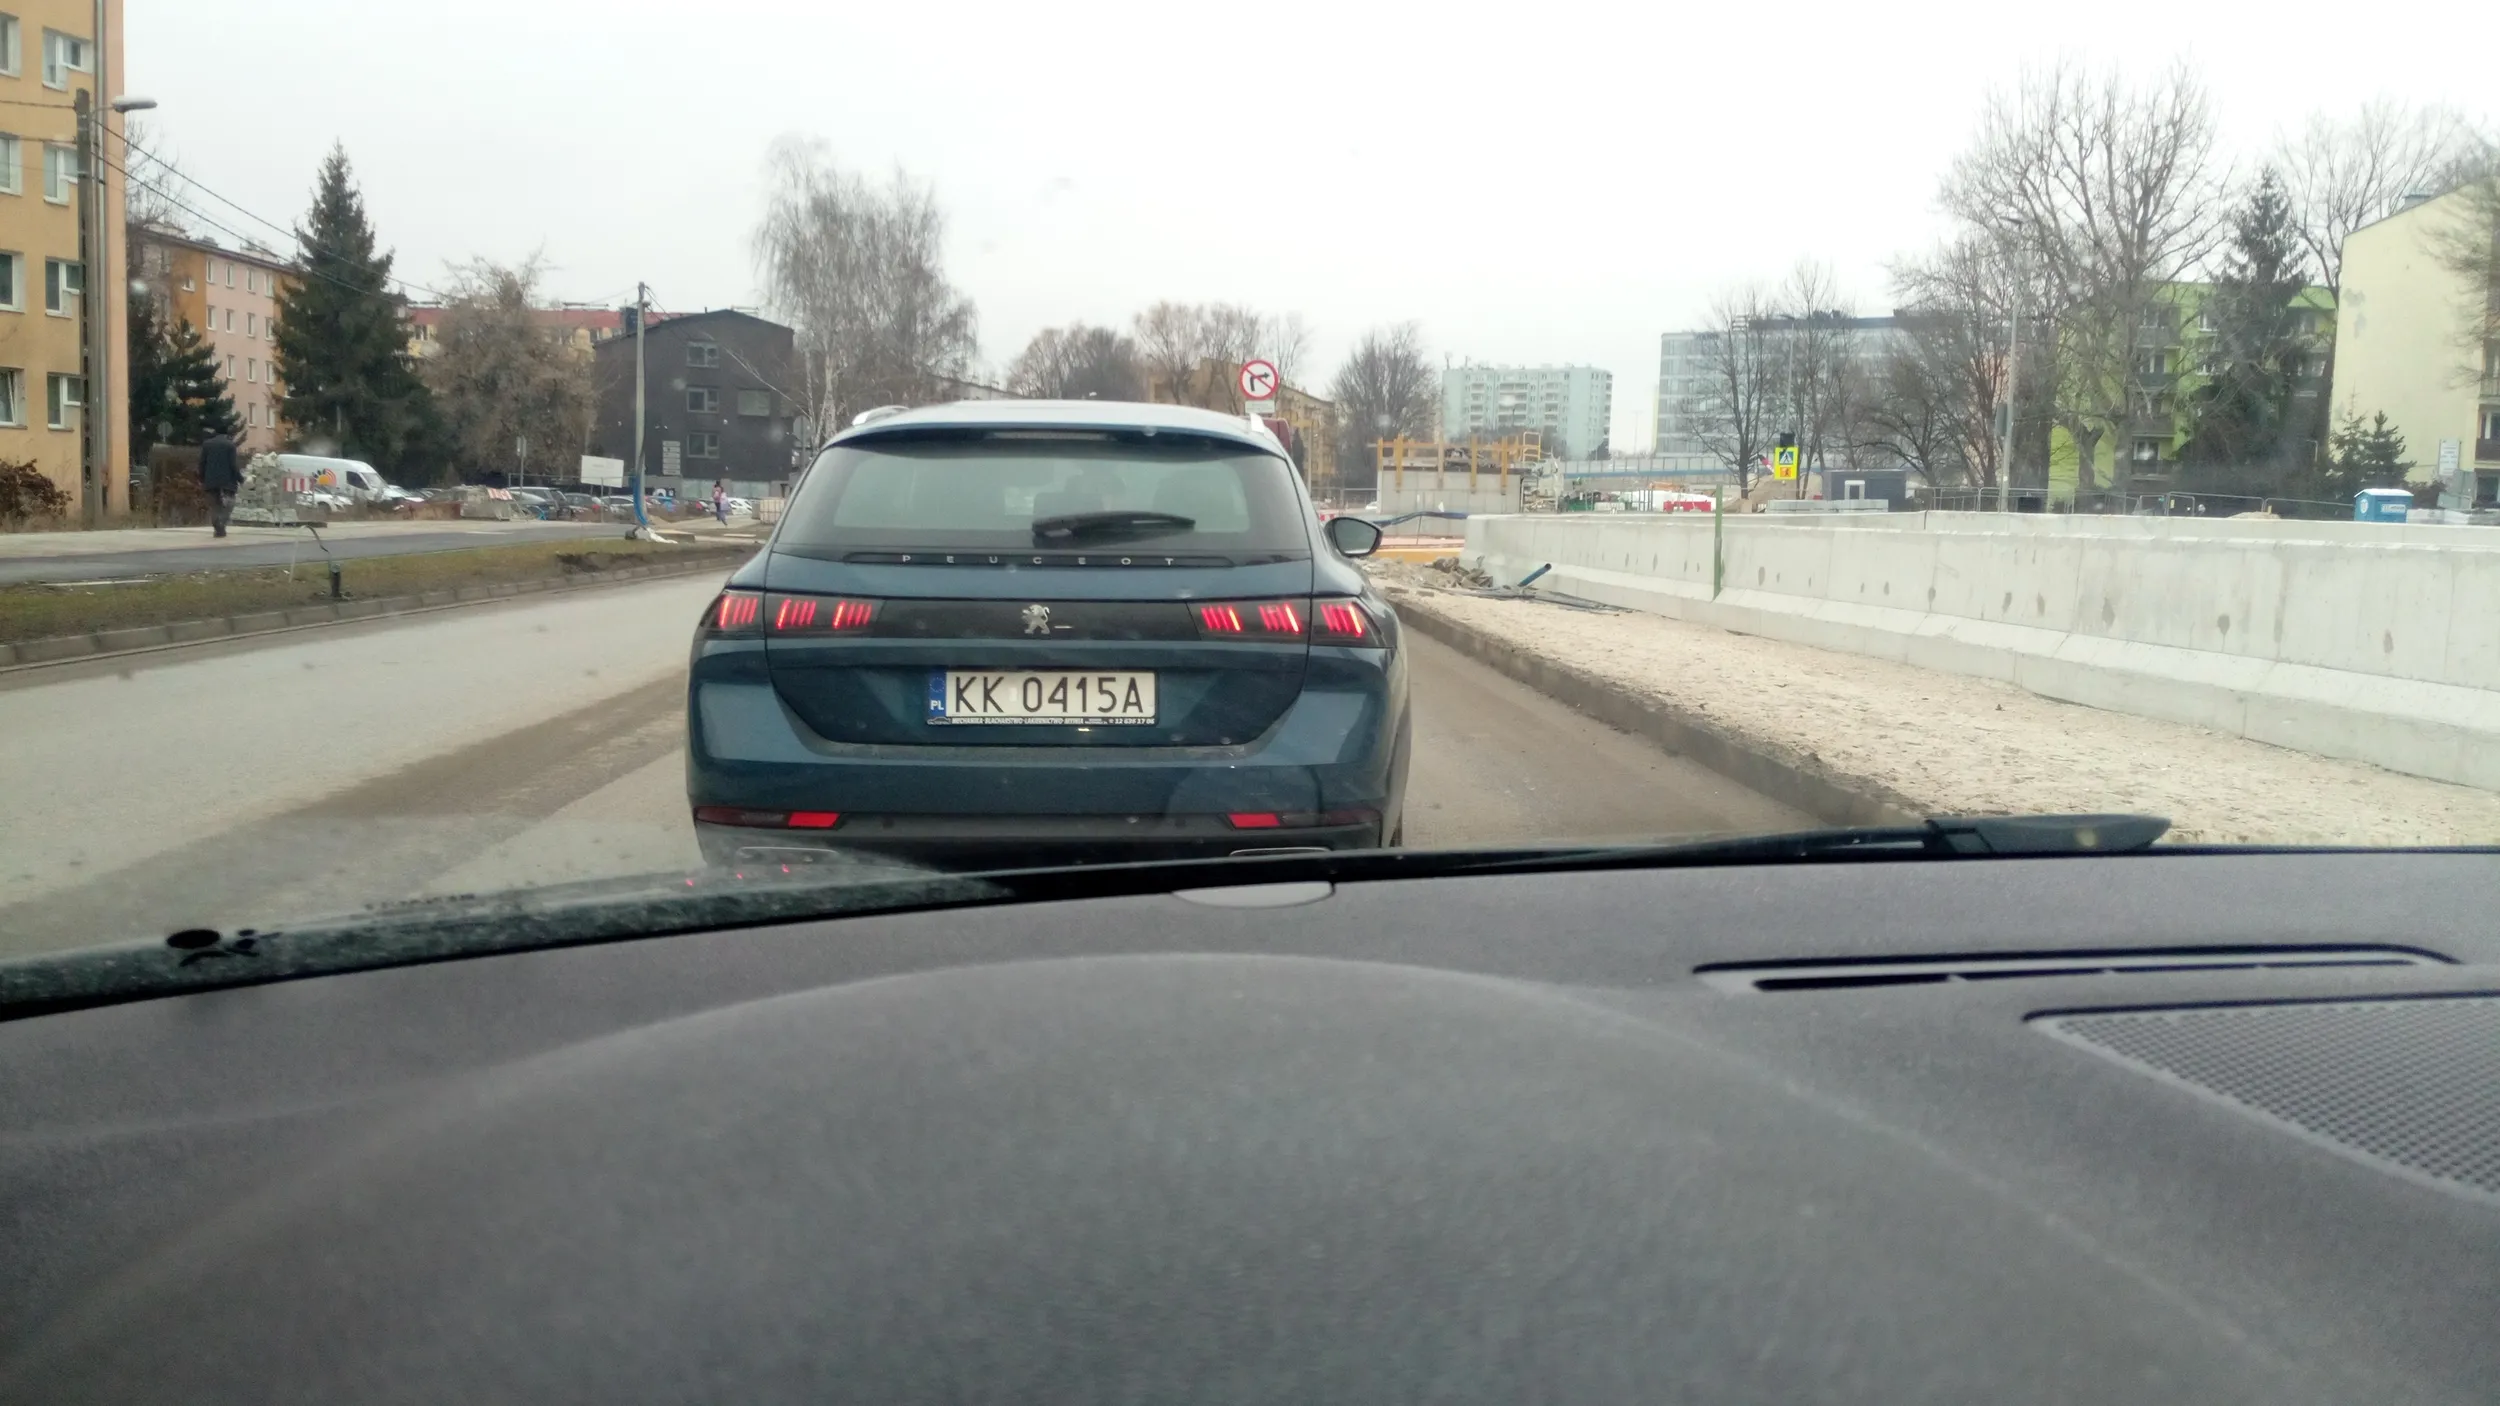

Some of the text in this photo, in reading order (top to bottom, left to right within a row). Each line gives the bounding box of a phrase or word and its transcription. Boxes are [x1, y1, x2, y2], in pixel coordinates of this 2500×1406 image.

[902, 555, 1174, 566] PEUGEOT
[955, 676, 1143, 713] KK 0415A
[930, 700, 944, 710] PL
